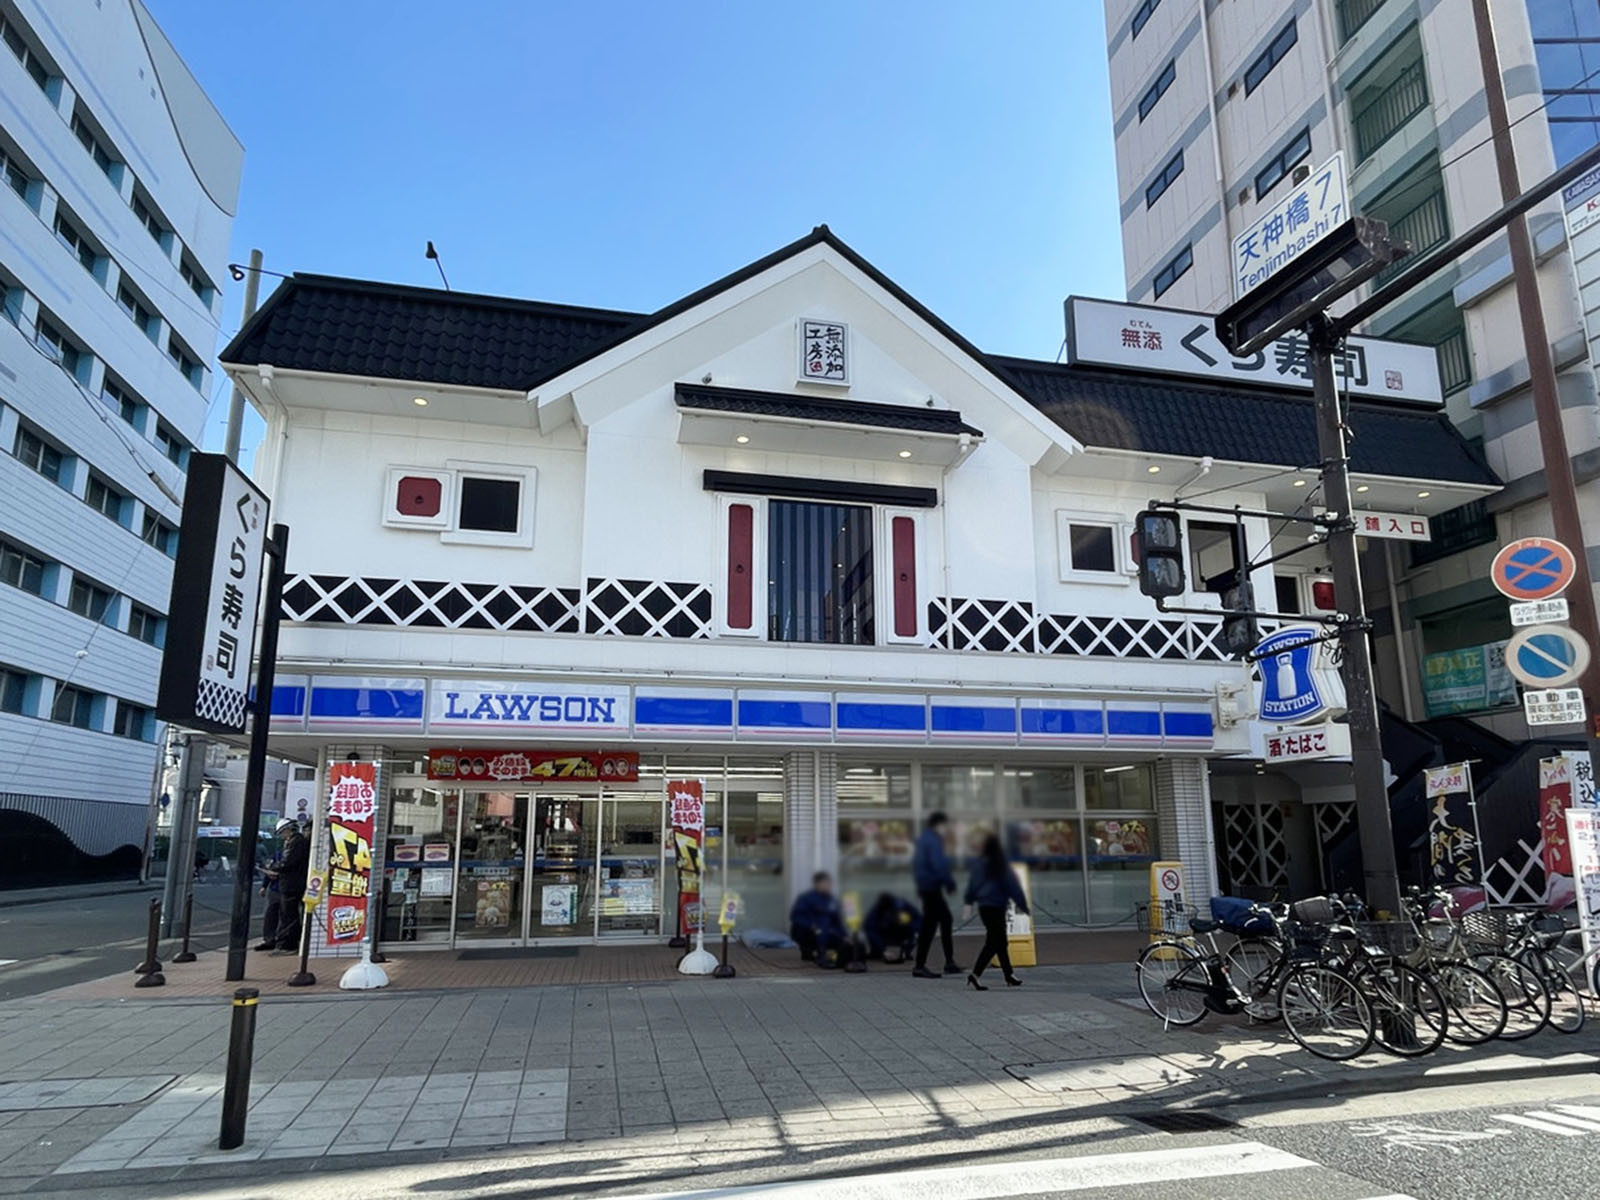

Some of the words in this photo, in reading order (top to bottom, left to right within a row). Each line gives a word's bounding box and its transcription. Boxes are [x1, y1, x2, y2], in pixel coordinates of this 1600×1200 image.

[1239, 215, 1329, 292] Tenjimbashi
[1331, 203, 1341, 224] 7
[1130, 320, 1152, 329] むてん
[825, 327, 844, 376] 無添加
[1121, 328, 1162, 350] 無添
[216, 492, 250, 680] くら寿司
[445, 693, 615, 722] LAWSON
[1265, 690, 1315, 713] STATION
[1269, 734, 1325, 757] 酒・たばこ
